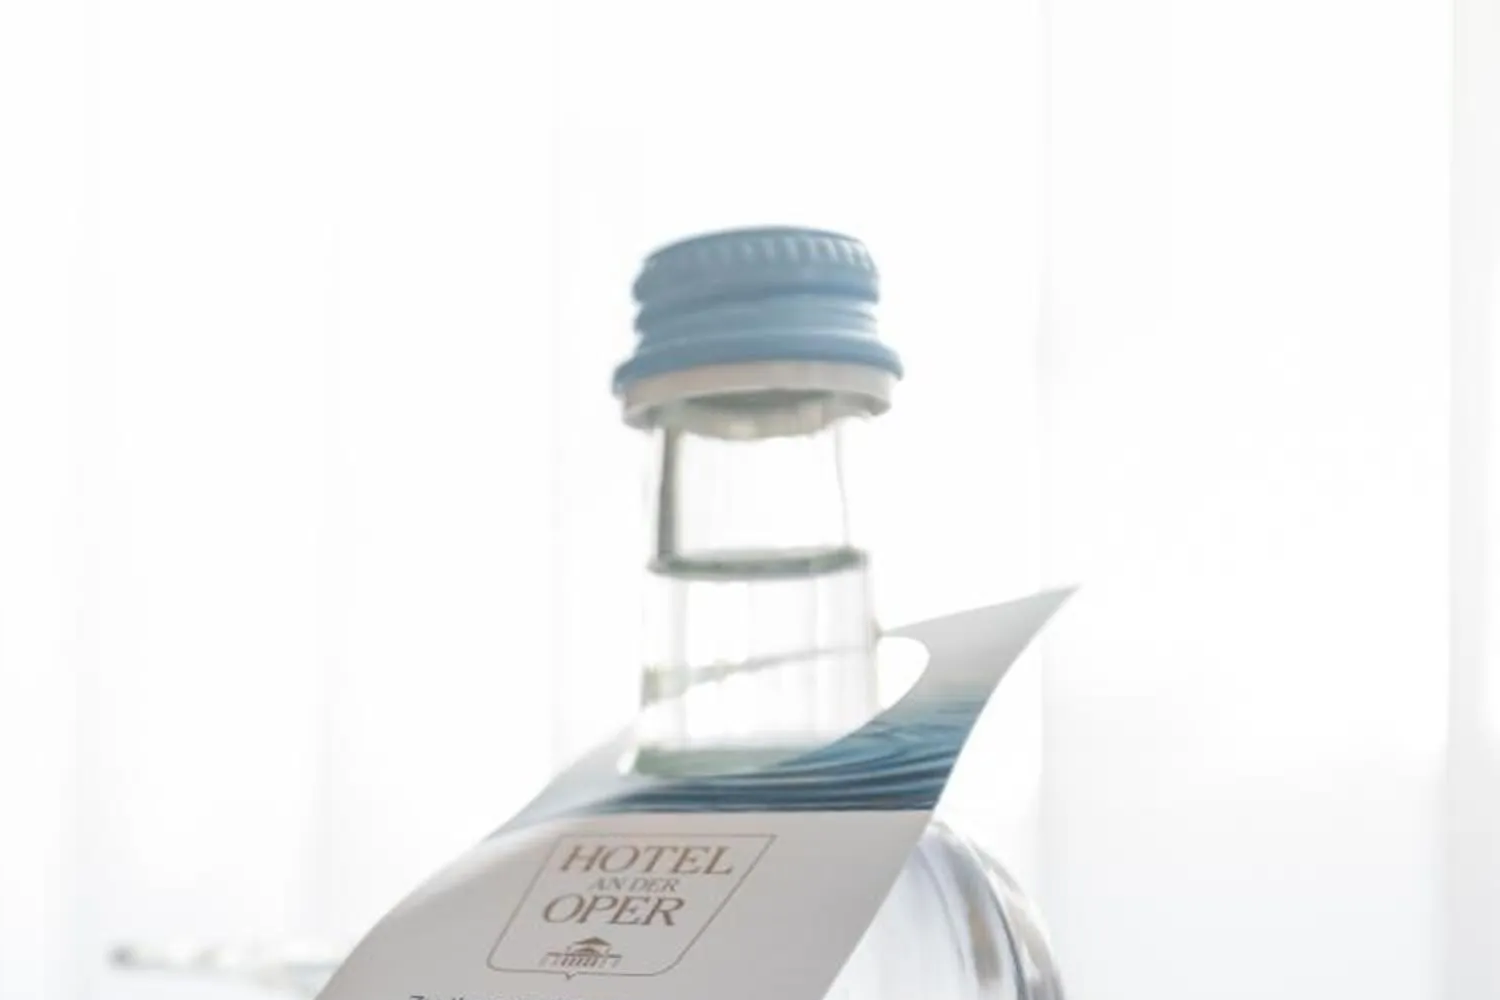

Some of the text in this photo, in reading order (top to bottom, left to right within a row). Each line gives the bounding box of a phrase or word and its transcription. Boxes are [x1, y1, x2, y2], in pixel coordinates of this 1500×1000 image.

[560, 845, 735, 875] HOTEL
[589, 877, 681, 893] AN DER
[542, 893, 686, 926] OPER
